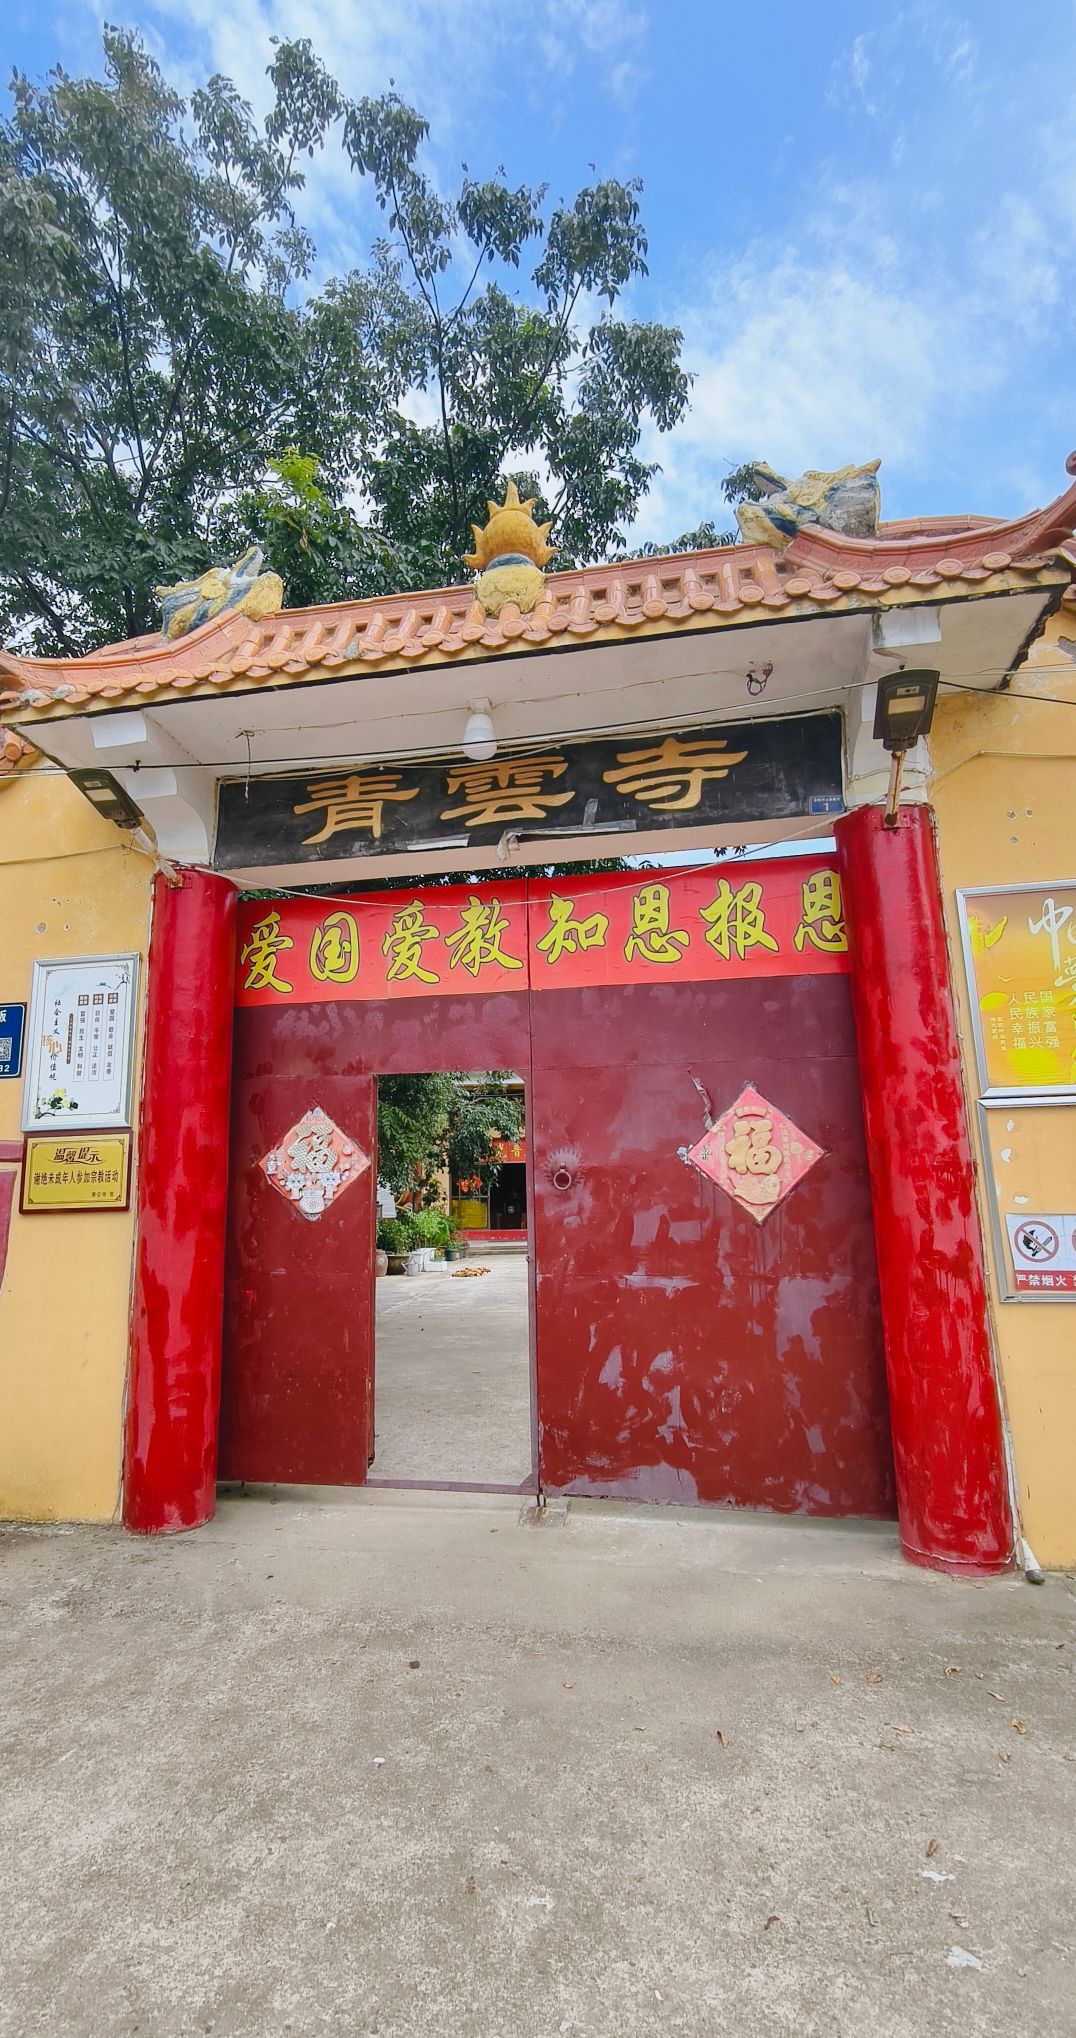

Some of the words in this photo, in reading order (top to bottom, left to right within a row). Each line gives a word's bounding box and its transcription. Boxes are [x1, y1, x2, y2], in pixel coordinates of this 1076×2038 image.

[294, 737, 748, 845] 青雲寺
[241, 868, 848, 993] 爱国爱教知恩报恩
[1008, 992, 1027, 1050] 人民幸福
[1024, 991, 1042, 1048] 民族振兴
[1040, 990, 1060, 1048] 国家富强
[53, 1146, 101, 1163] 温馨提示
[725, 1119, 783, 1175] 福
[33, 1169, 119, 1186] 谢绝未成年人参加宗教活动
[1016, 1274, 1068, 1287] 严禁烟火
